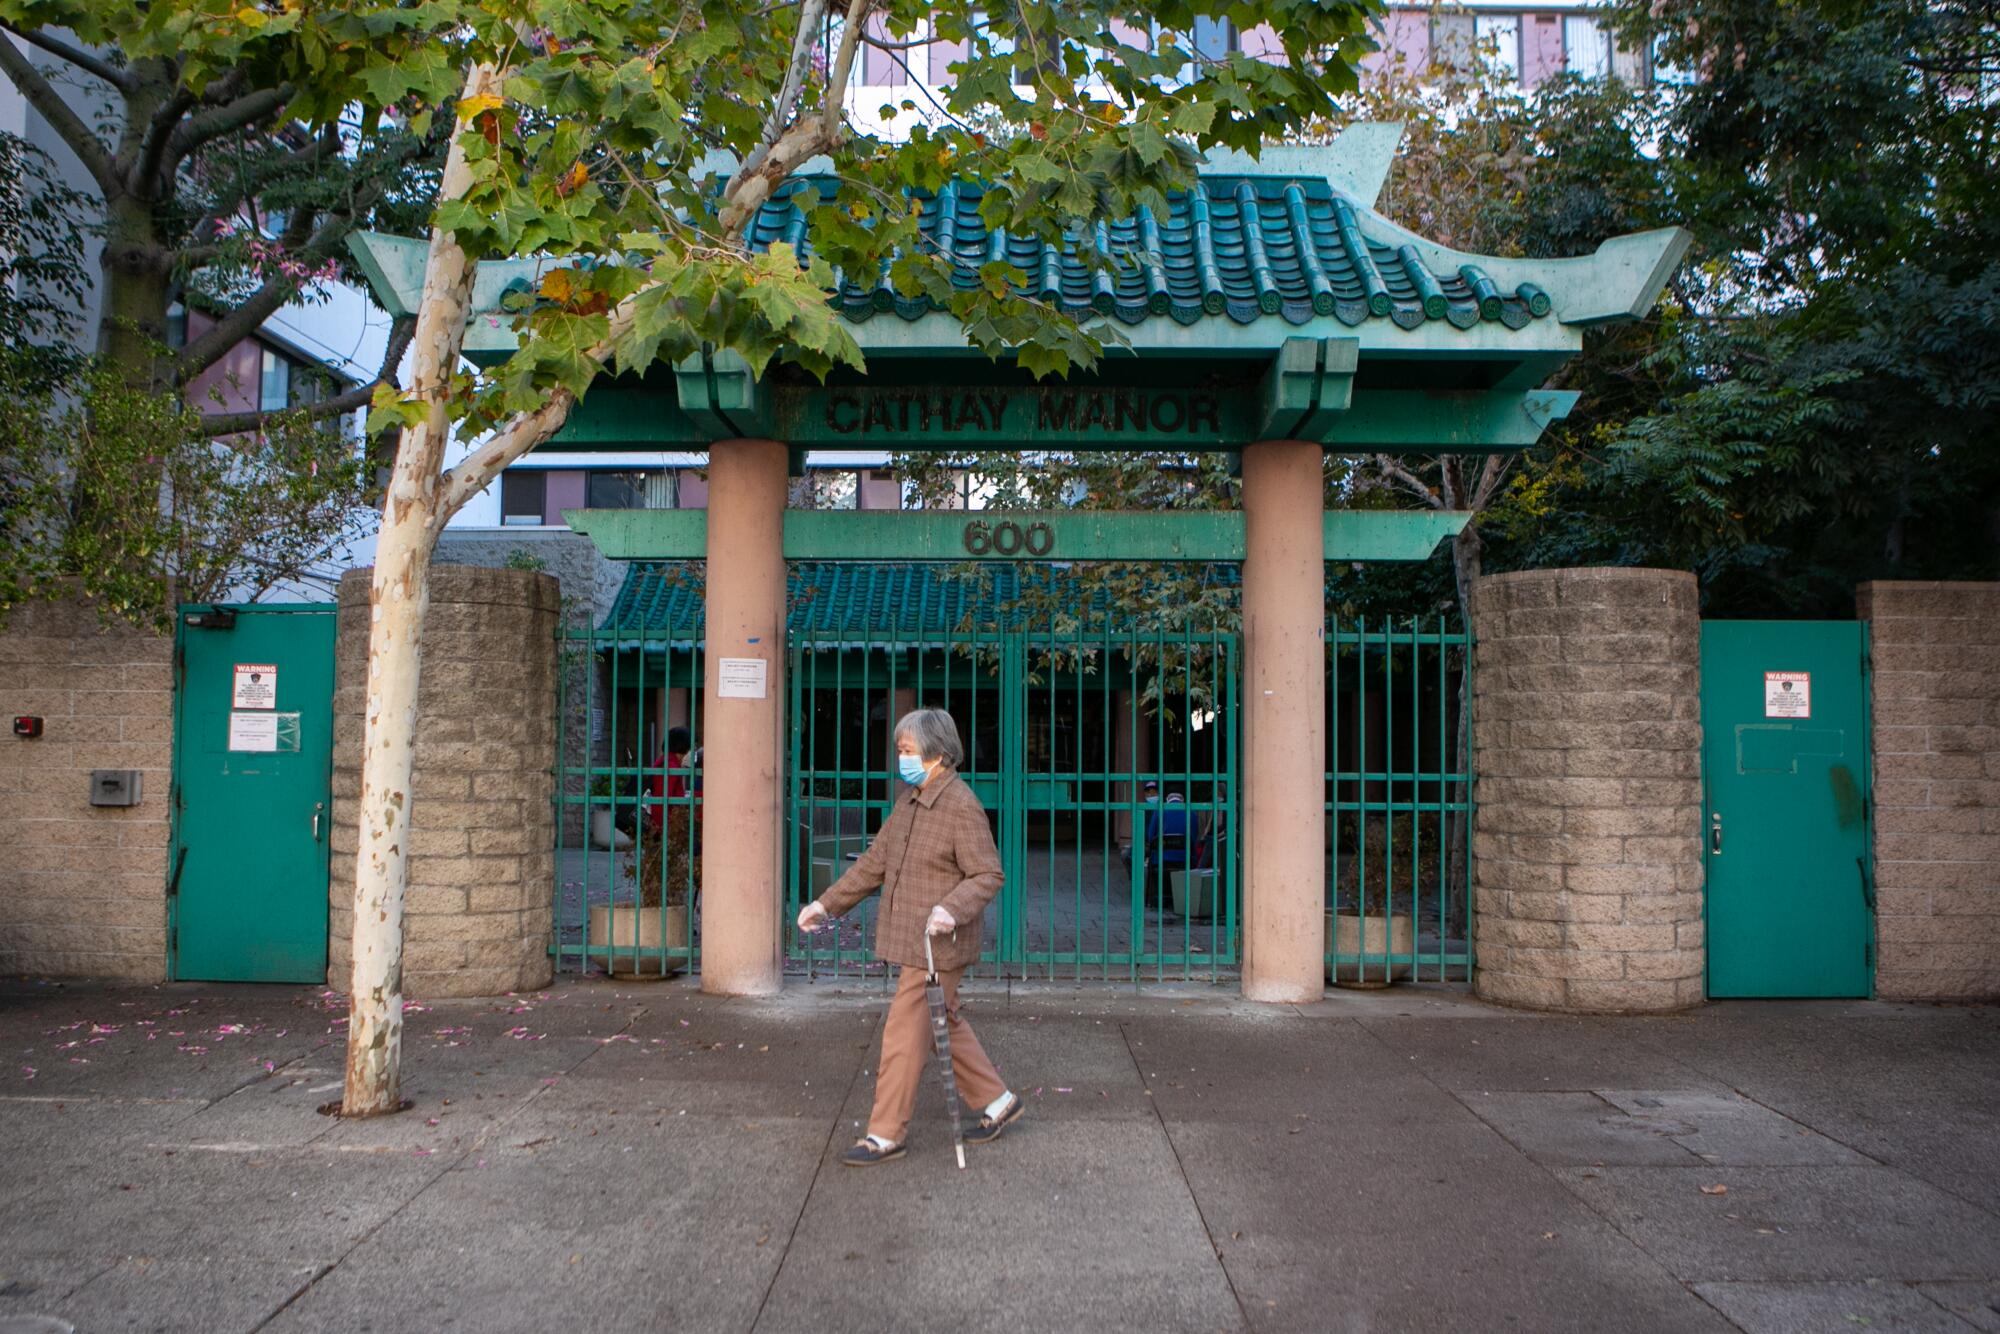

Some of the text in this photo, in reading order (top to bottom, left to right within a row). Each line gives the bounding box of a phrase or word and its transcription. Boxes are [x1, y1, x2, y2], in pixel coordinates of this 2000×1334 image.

[827, 393, 1221, 433] CATHAY MANOR
[964, 519, 1055, 556] 600
[237, 665, 277, 673] WARNING
[1766, 673, 1809, 681] WARNING
